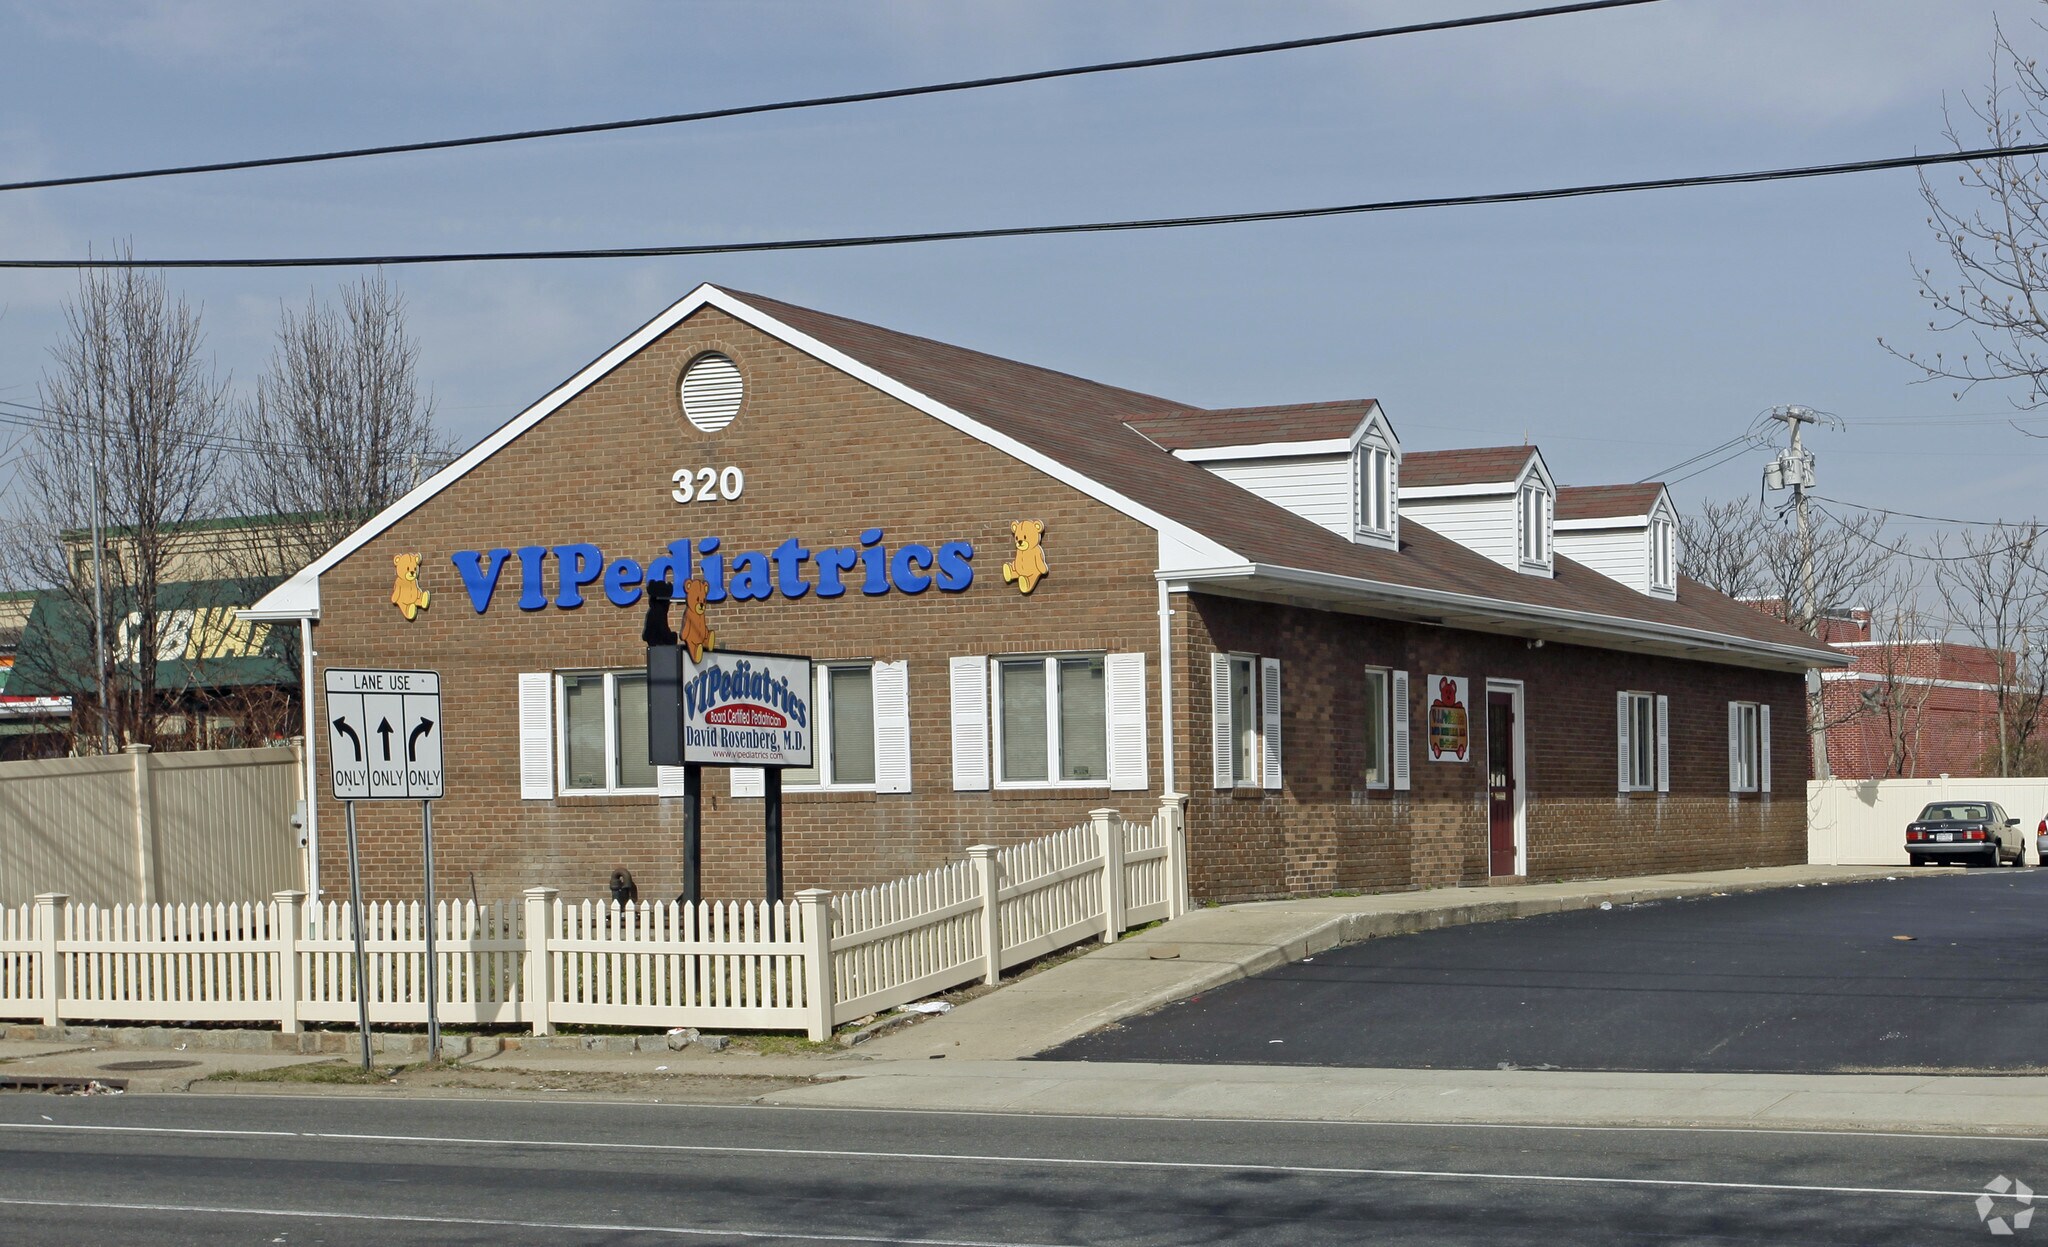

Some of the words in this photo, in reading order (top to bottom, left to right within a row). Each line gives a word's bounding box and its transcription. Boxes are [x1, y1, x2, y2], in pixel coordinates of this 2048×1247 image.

[672, 466, 743, 504] 320
[451, 528, 974, 614] VIPediatrics
[354, 674, 383, 690] LANE
[389, 675, 411, 690] USE
[684, 659, 807, 729] VIPediatrics
[710, 709, 726, 723] Board
[727, 708, 750, 725] Certified
[751, 709, 782, 726] Pediatrician
[686, 725, 718, 747] David
[720, 727, 781, 752] Rosenberg,
[783, 729, 806, 751] M.D.
[712, 749, 784, 760] www.vipediatricscom
[335, 769, 366, 787] ONLY
[372, 769, 404, 787] ONLY
[409, 769, 441, 787] ONLY
